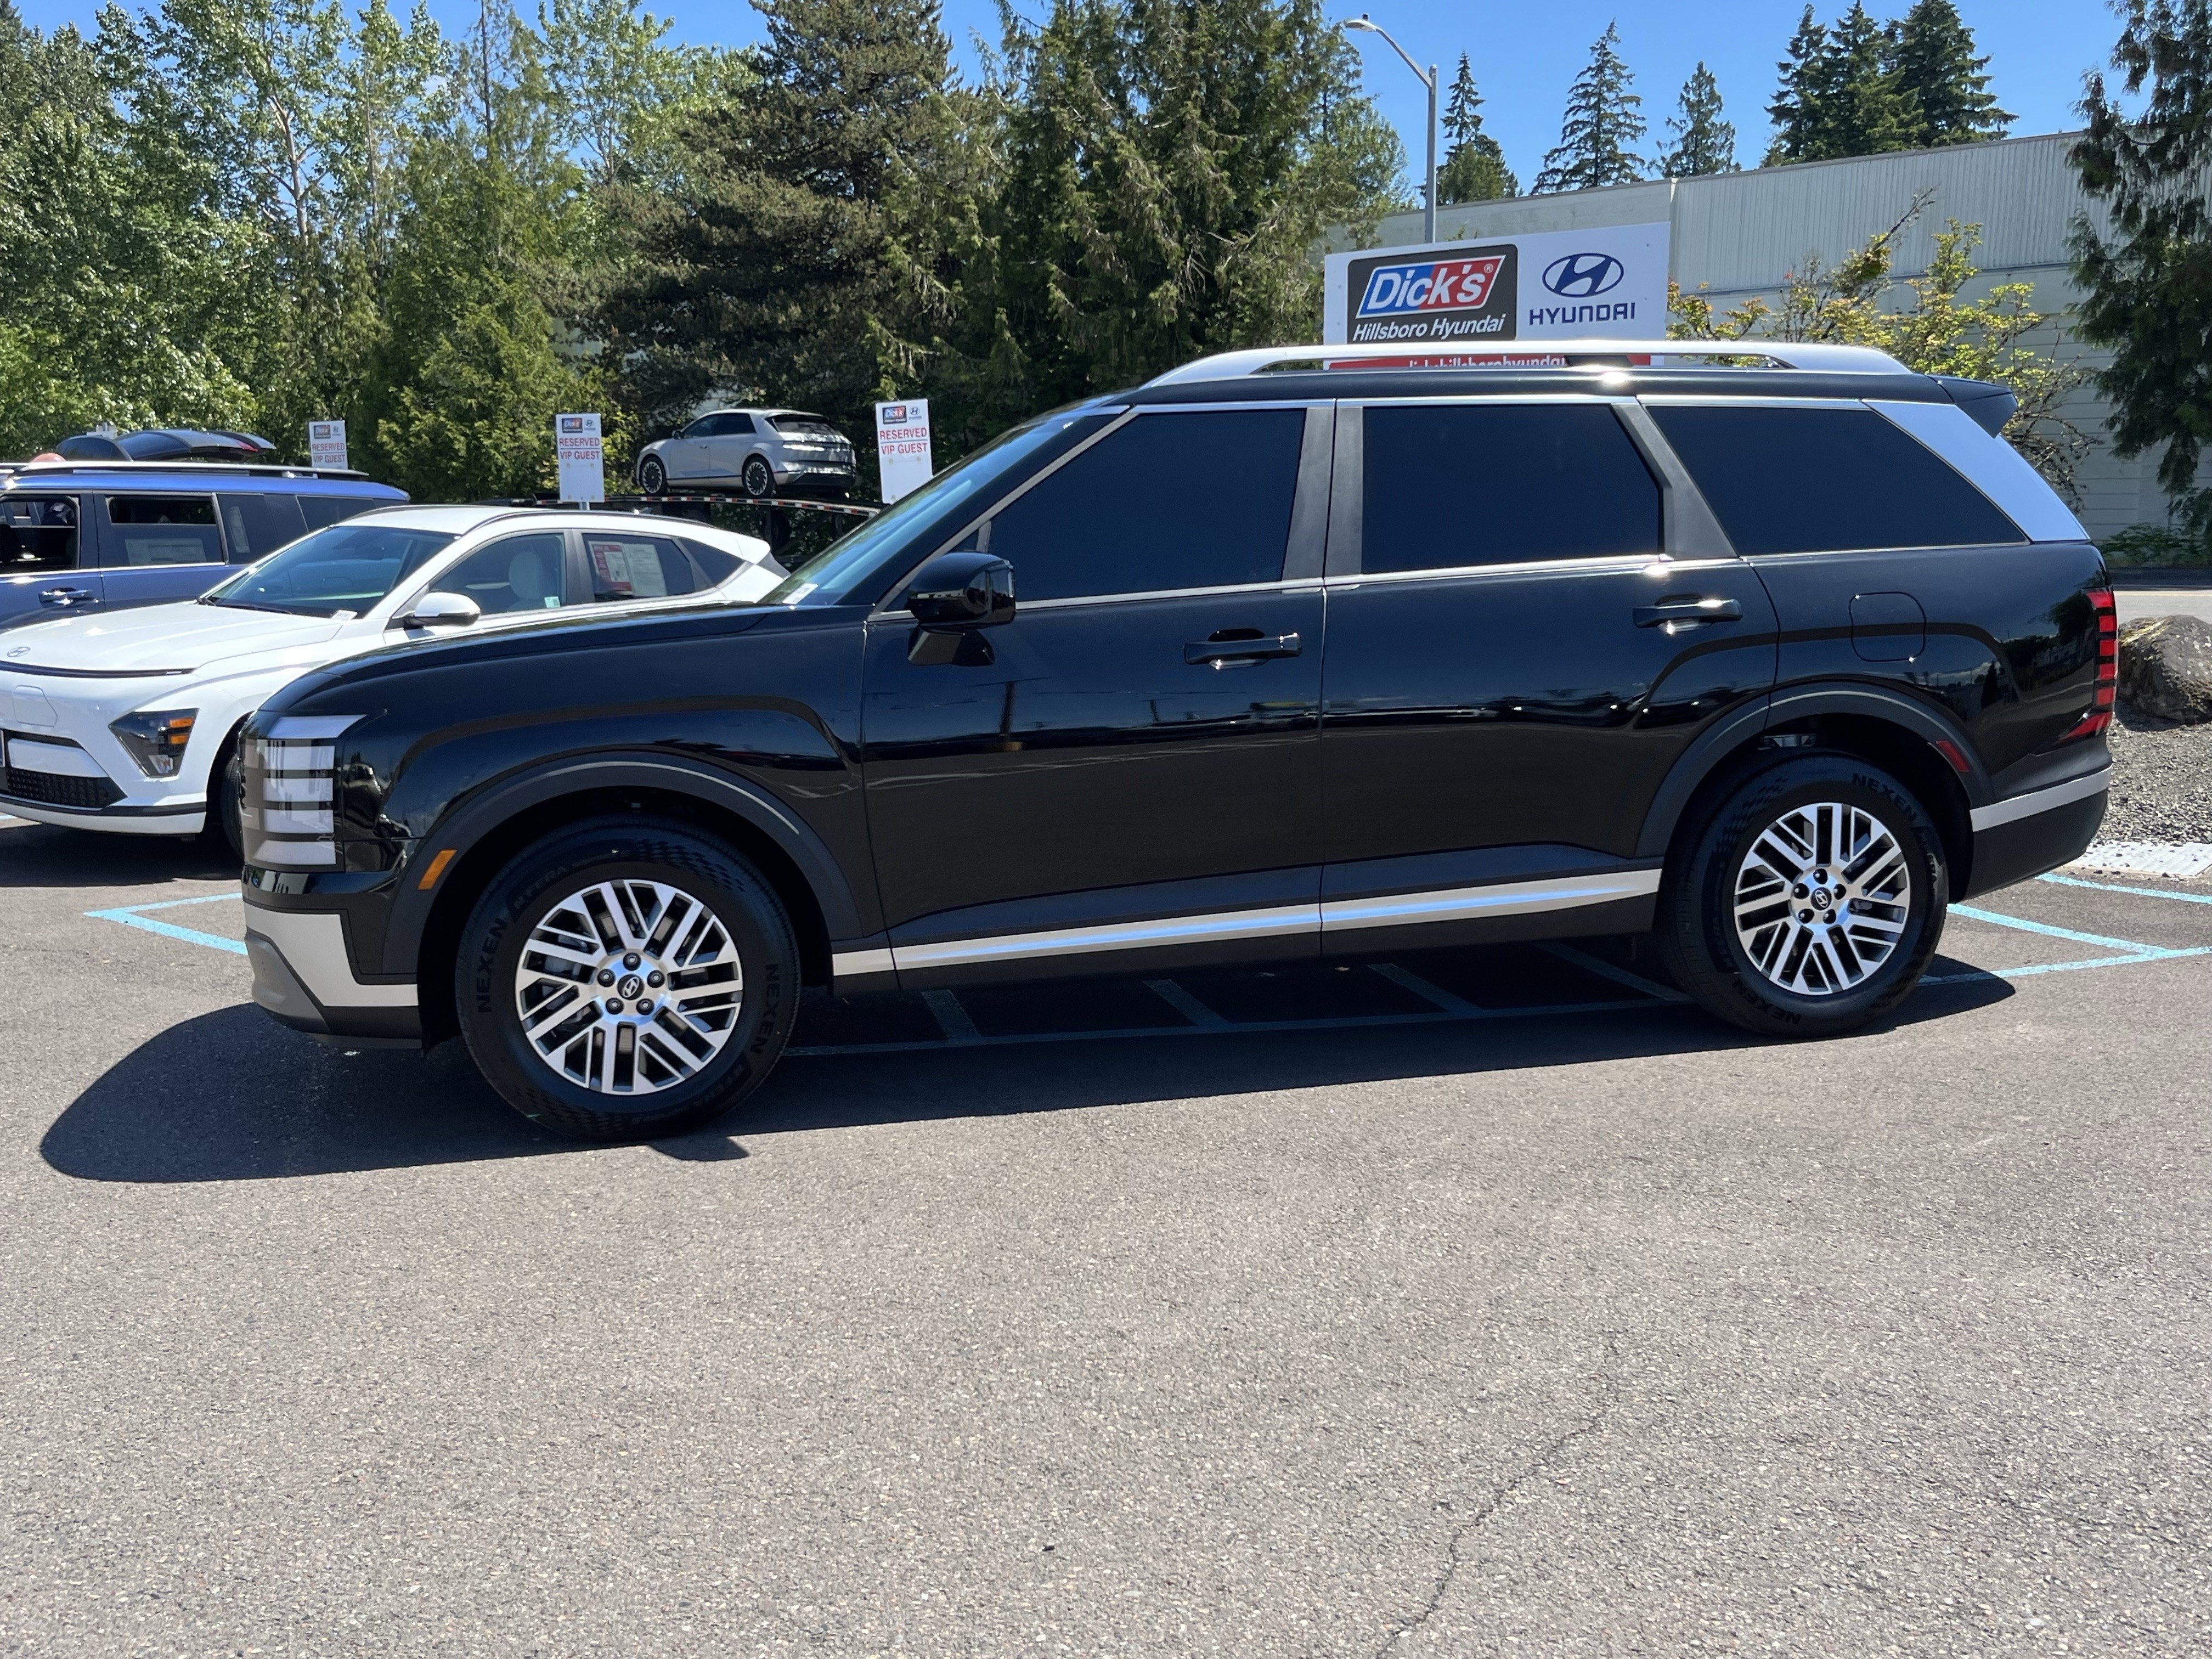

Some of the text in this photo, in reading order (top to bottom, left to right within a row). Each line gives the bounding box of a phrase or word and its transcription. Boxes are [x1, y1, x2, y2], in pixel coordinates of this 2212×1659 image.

[1529, 302, 1636, 326] HYUNDAI
[1352, 313, 1506, 342] Hillsboro Hyundai
[559, 438, 600, 447] RESERVED
[879, 427, 927, 440] RESERVED
[312, 442, 345, 451] RESERVED
[560, 451, 600, 460] VIP GUEST
[881, 442, 928, 455] VIP GUEST
[324, 454, 346, 463] GUEST
[1852, 772, 1917, 822] NEXEN
[477, 917, 509, 1013] NEXEN
[752, 963, 779, 1054] NEXEN
[1732, 978, 1801, 1025] NEXEN
